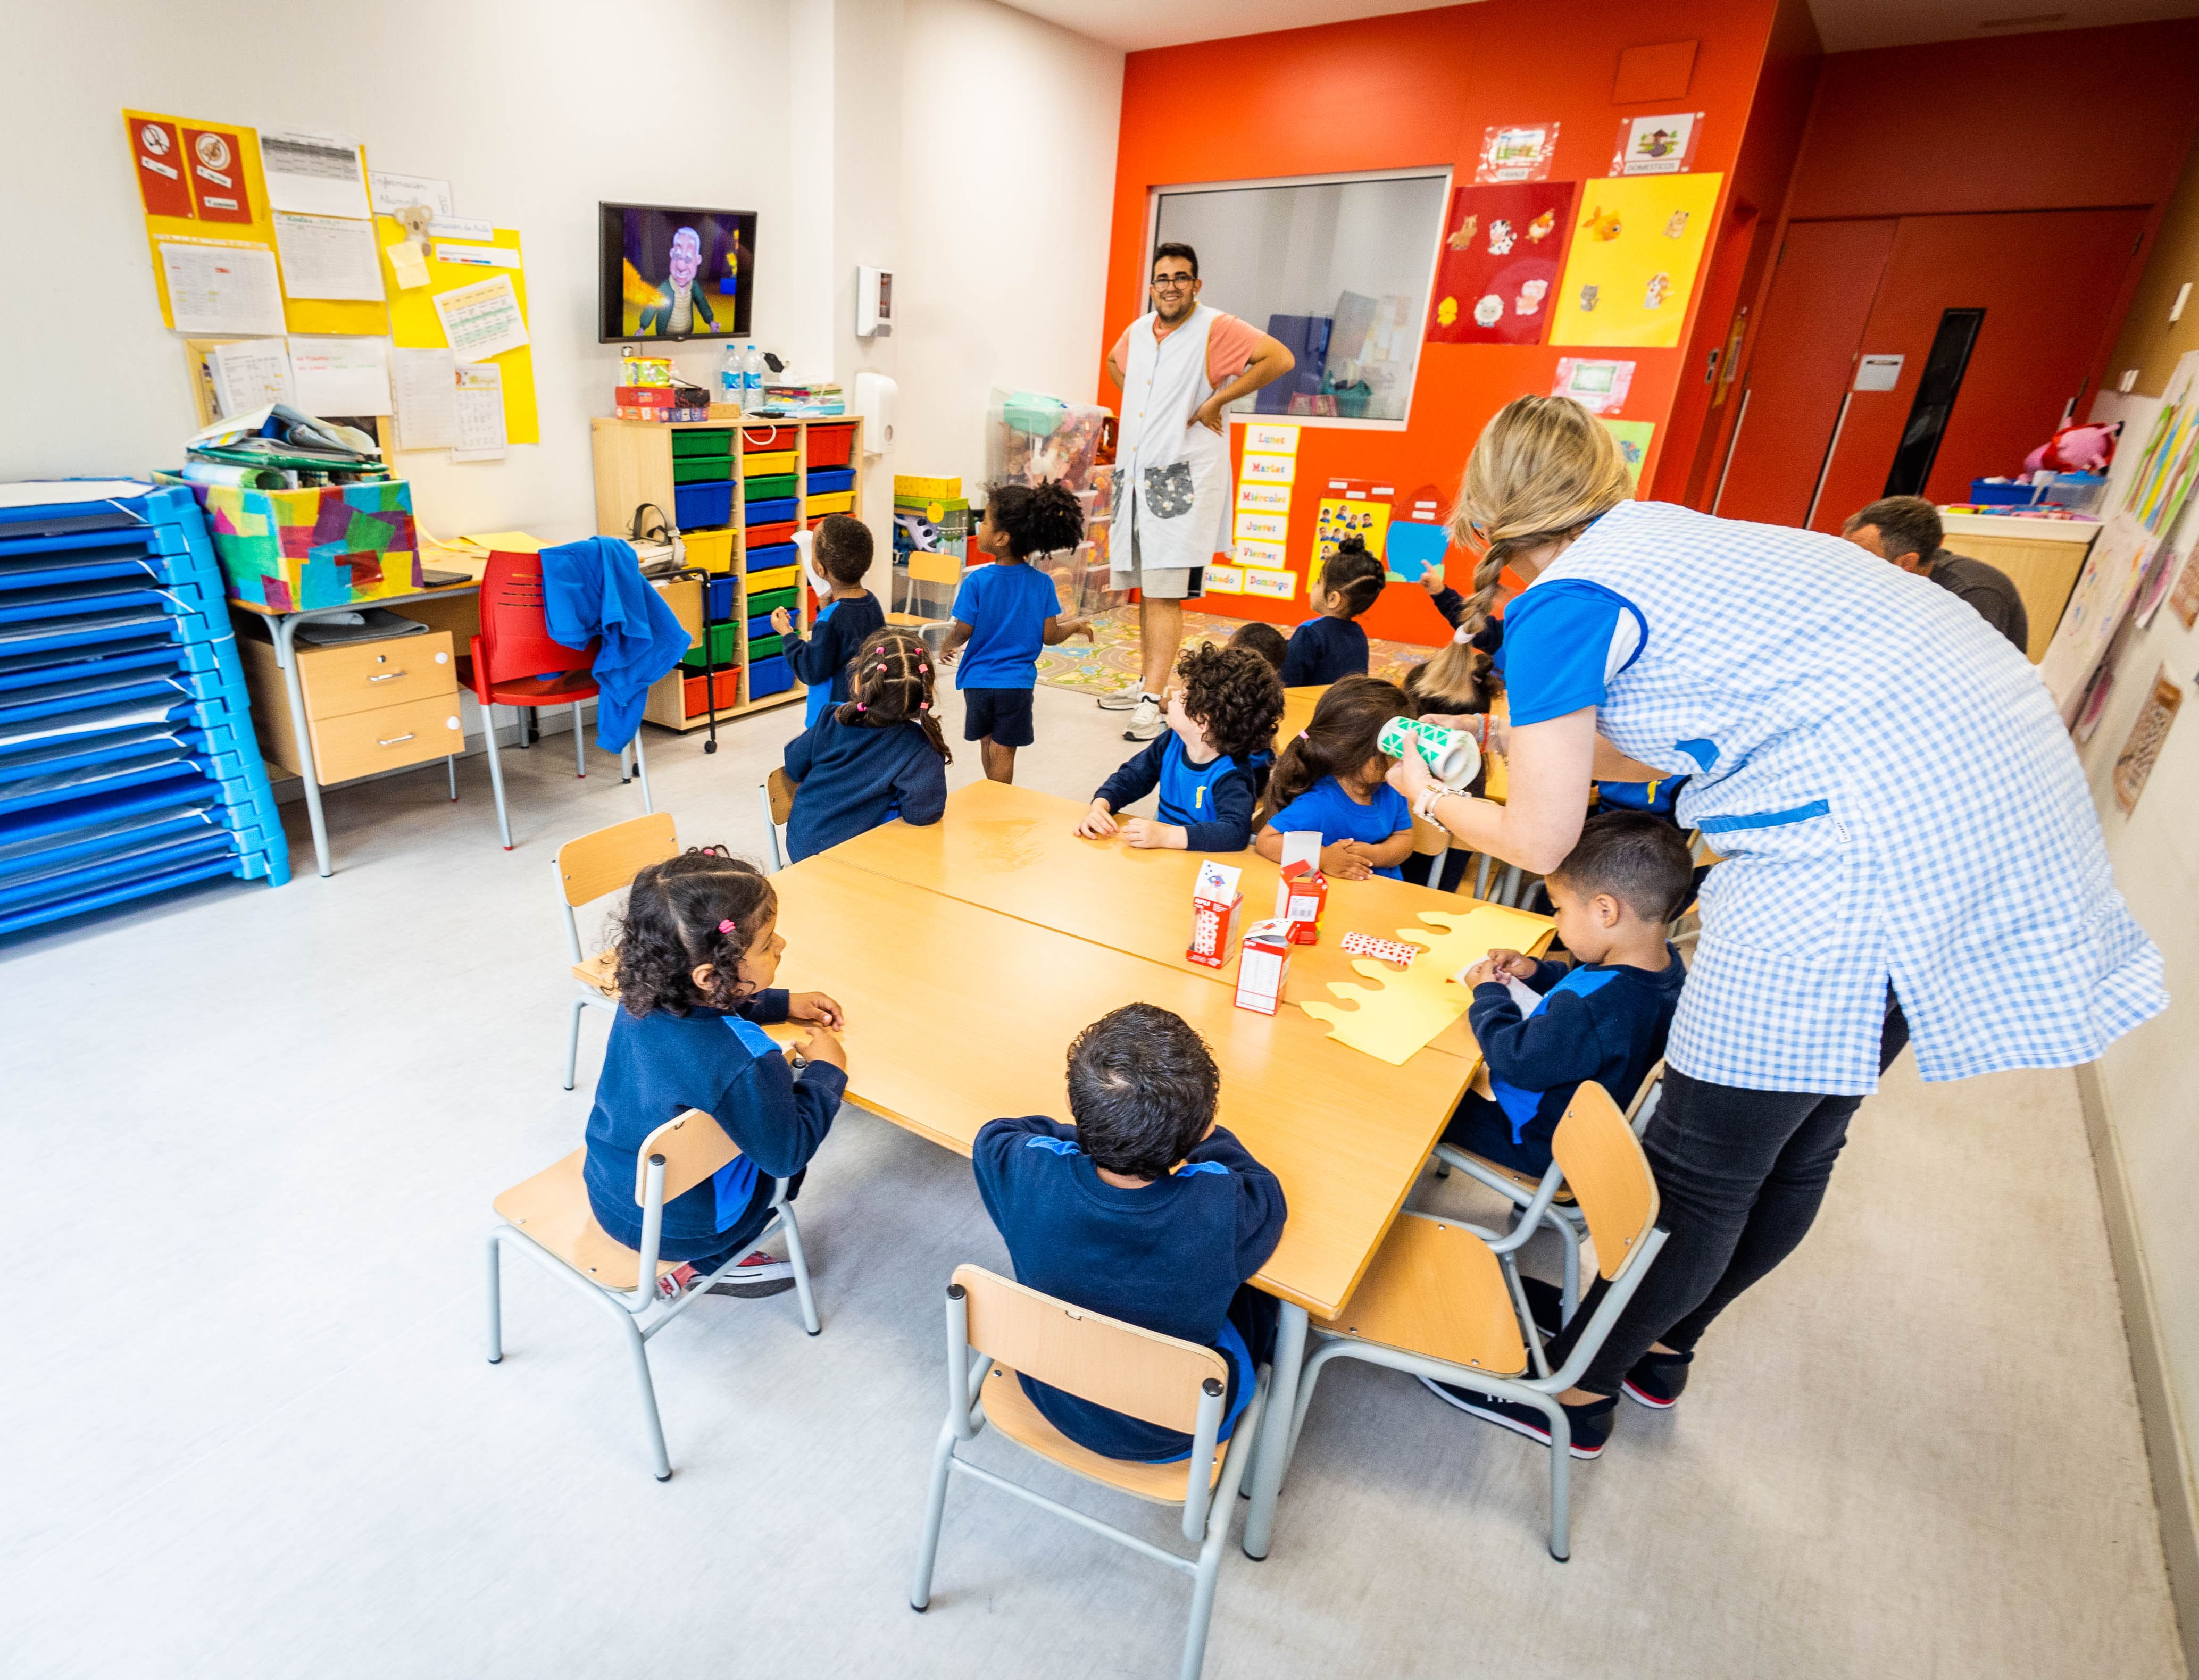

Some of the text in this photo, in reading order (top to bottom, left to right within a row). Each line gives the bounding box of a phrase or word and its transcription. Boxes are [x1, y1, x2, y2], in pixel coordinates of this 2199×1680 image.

[1258, 432, 1286, 445] Lunes
[1252, 462, 1286, 474] Martes
[1242, 491, 1286, 504] Miércoles
[1246, 521, 1277, 532] Jueves
[1243, 547, 1277, 561] Viernes
[1250, 575, 1289, 591] Domingo
